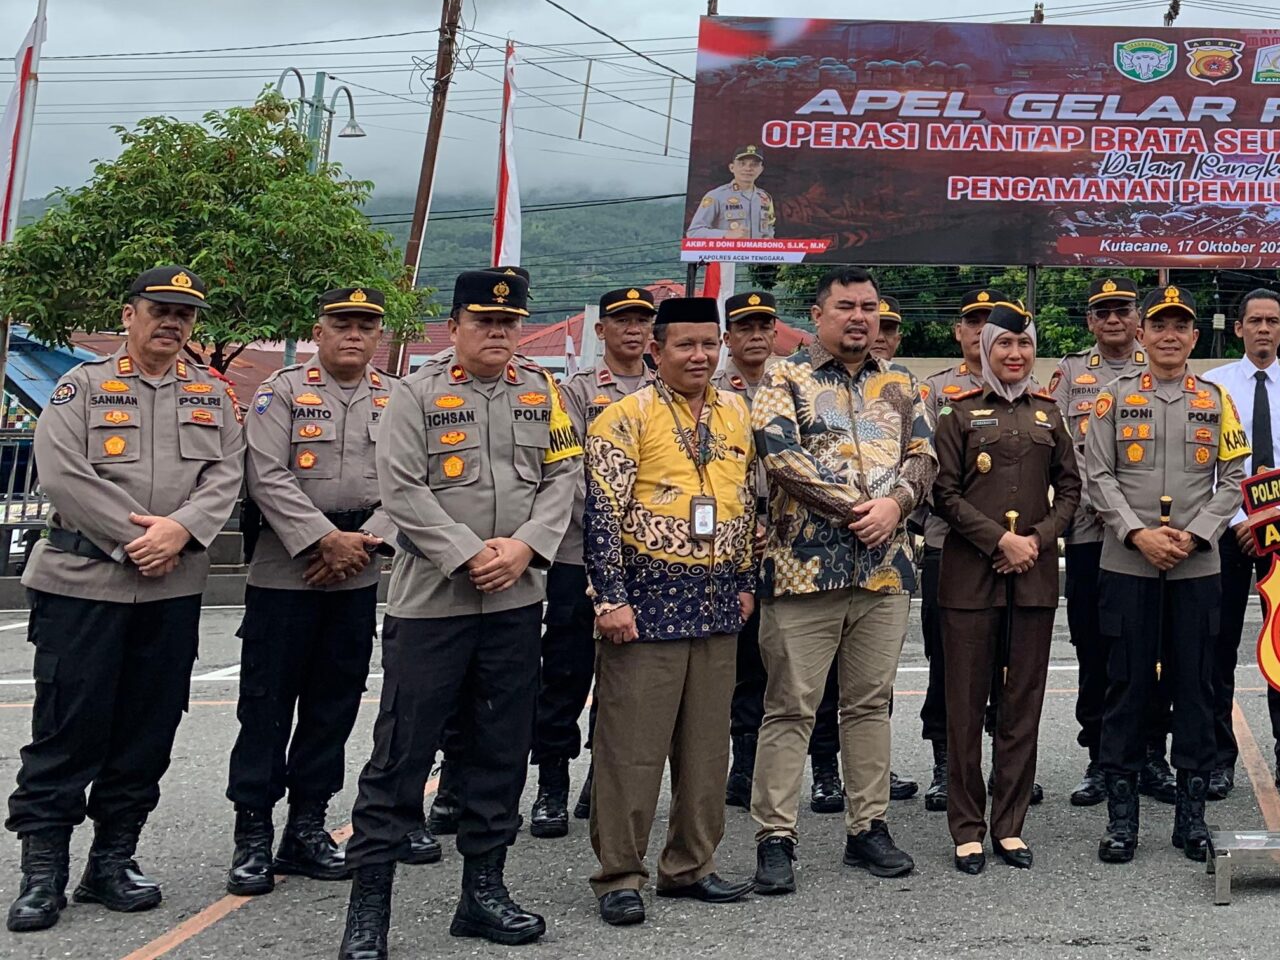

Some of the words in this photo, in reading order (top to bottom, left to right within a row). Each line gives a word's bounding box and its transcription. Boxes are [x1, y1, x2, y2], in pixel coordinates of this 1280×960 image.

[795, 89, 982, 117] APEL
[1008, 93, 1236, 123] GELAR
[763, 121, 918, 150] OPERASI
[927, 124, 1084, 152] MANTAP
[1093, 126, 1207, 154] BRATA
[1101, 152, 1184, 179] Dalam
[948, 176, 1172, 203] PENGAMANAN
[1100, 240, 1172, 254] Kutacane,
[1177, 241, 1193, 253] 17
[1198, 240, 1255, 253] Oktober
[91, 395, 138, 406] SANIMAN
[179, 396, 221, 406] POLRI
[428, 411, 475, 427] ICHSAN
[1120, 408, 1152, 418] DONI
[1188, 412, 1219, 423] POLRI
